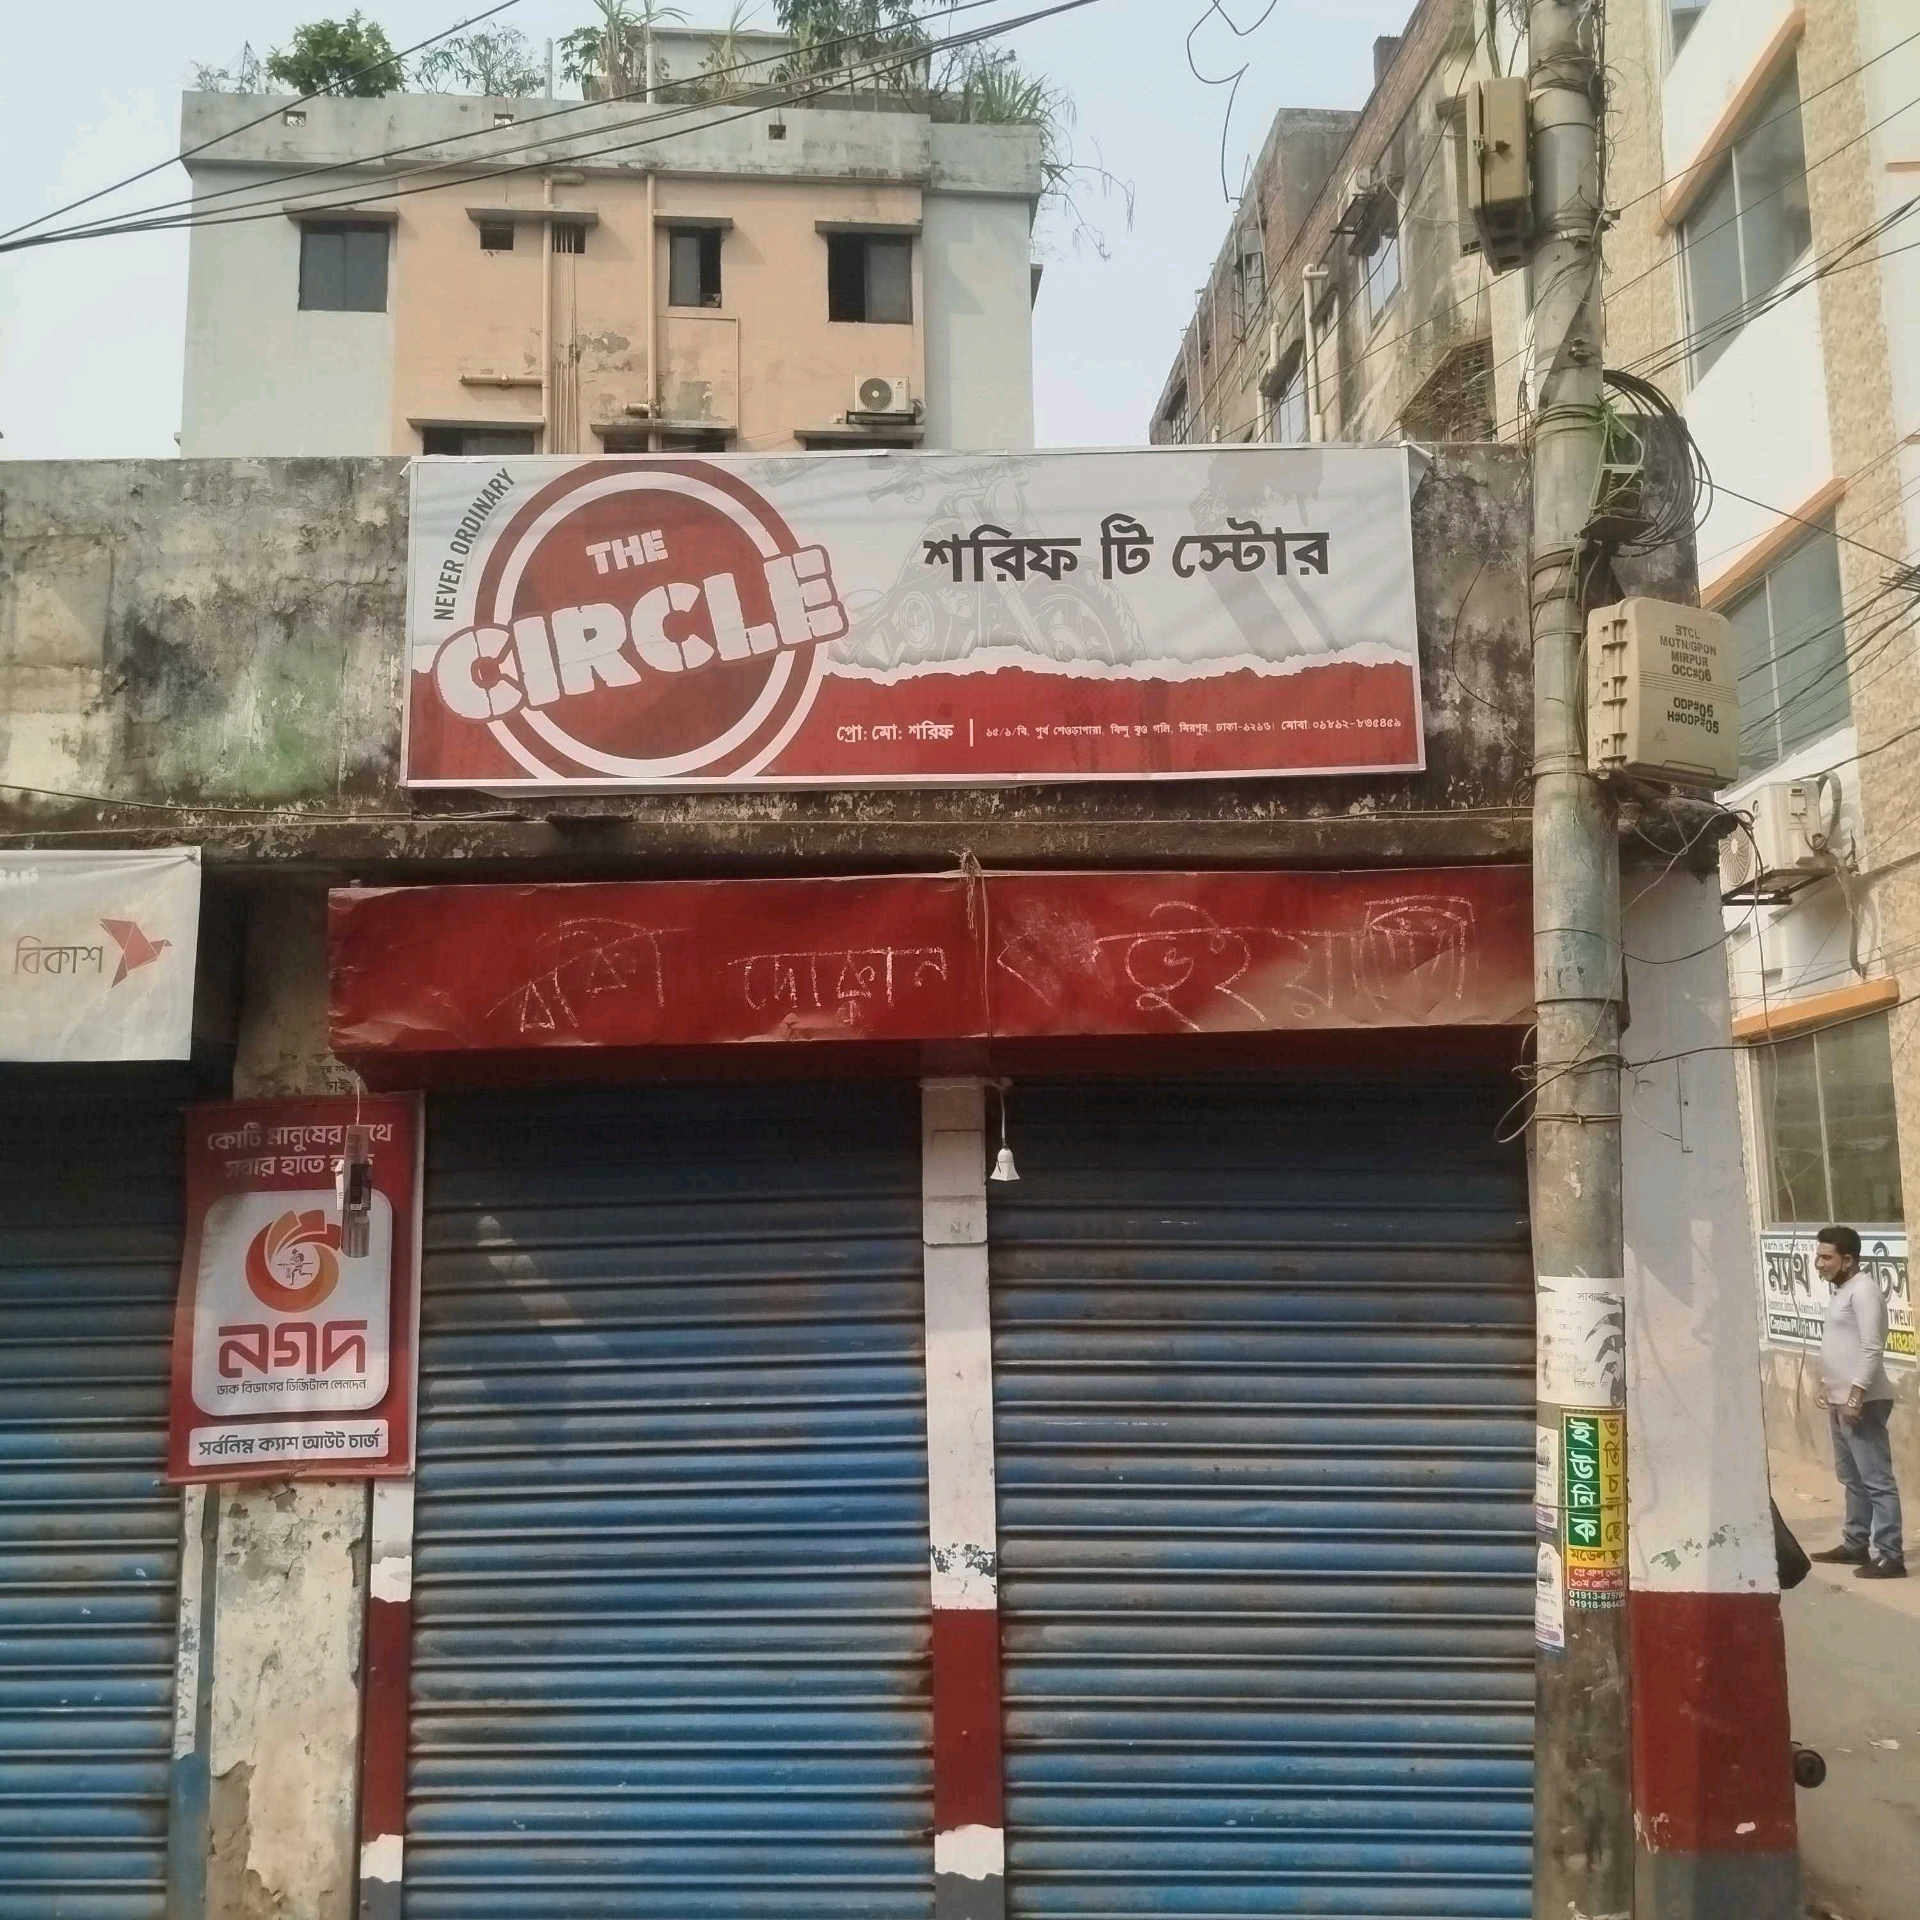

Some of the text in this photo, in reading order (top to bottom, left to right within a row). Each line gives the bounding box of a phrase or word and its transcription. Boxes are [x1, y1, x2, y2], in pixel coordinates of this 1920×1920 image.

[434, 467, 515, 621] NEVER ORDINARY
[586, 529, 668, 575] THE
[923, 513, 1330, 583] শরিফ টি স্টোর
[437, 553, 844, 720] CIRCLE
[1671, 650, 1709, 668] MIRPUR
[908, 720, 954, 740] শরিফ
[15, 936, 103, 975] বিকাশ
[208, 1122, 262, 1150] কোটি
[267, 1125, 342, 1152] মানুষের
[281, 1155, 325, 1176] হাতে
[219, 1320, 367, 1378] নগদ
[216, 1378, 366, 1396] ডাক বিভাগের ডিজিটাল লেনদেন
[199, 1434, 255, 1456] সর্বনিম্ন
[258, 1436, 298, 1452] ক্যাশ
[302, 1430, 345, 1450] আউট
